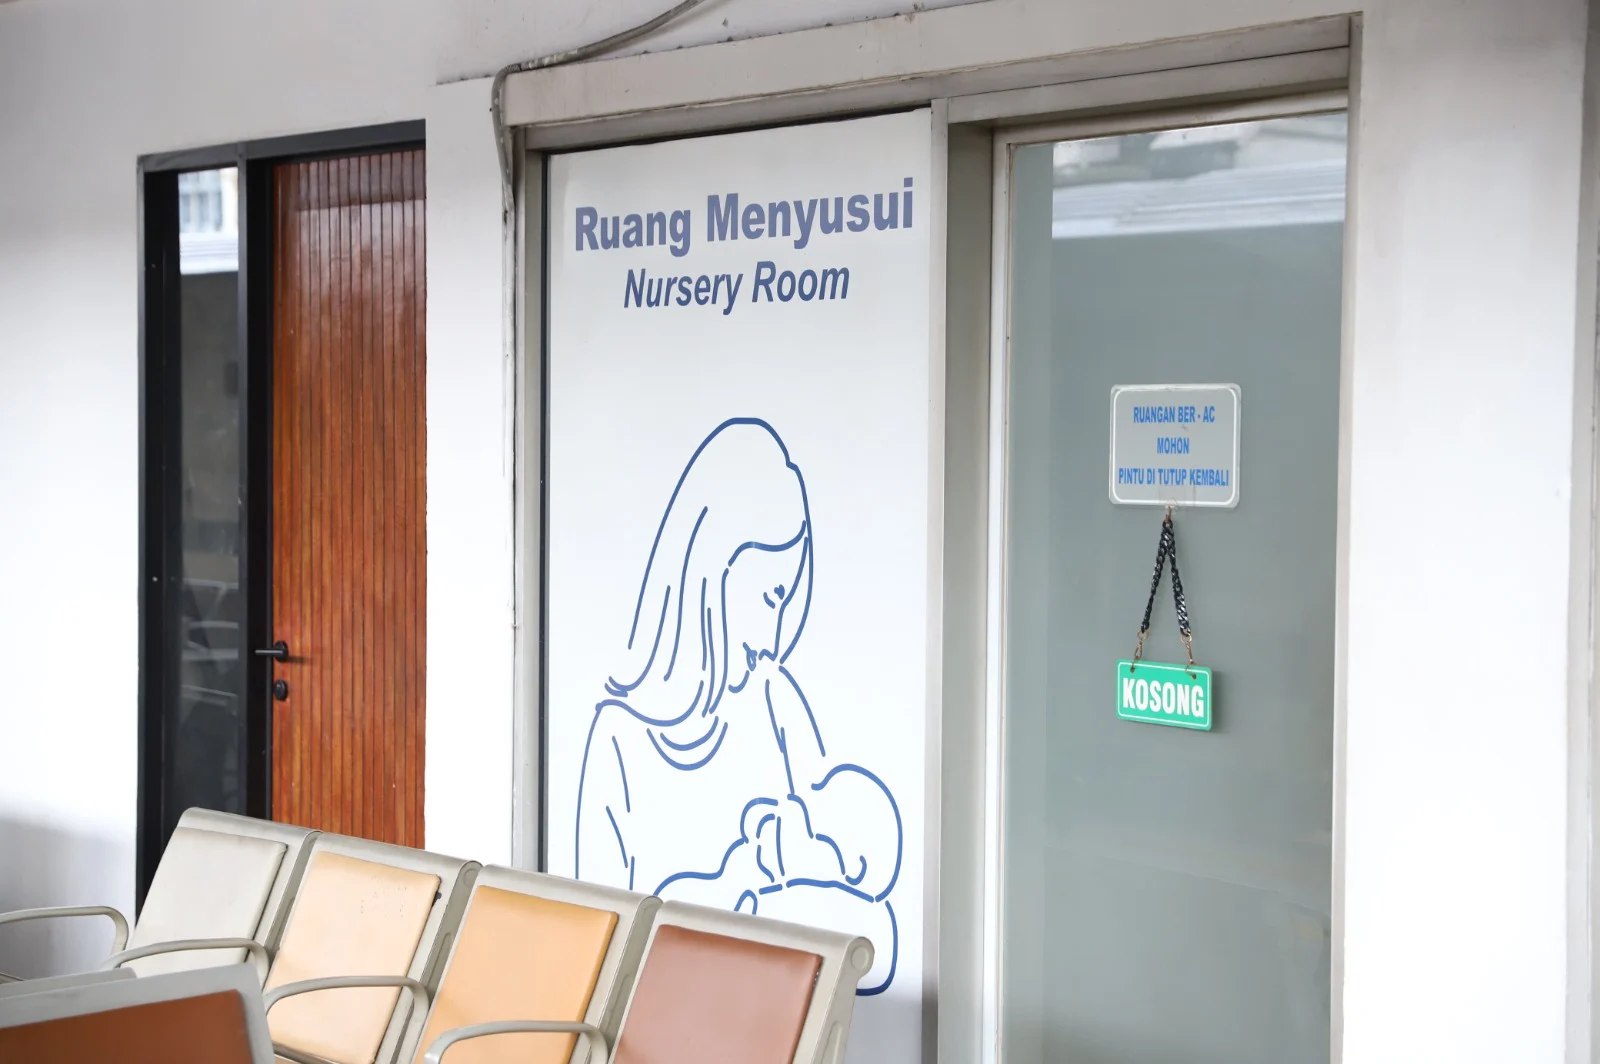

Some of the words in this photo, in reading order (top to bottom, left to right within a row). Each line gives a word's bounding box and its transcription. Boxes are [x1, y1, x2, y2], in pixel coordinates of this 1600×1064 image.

[575, 206, 691, 257] Ruang
[707, 177, 913, 249] Menyusui
[624, 268, 743, 315] Nursery
[752, 261, 850, 303] Room
[1133, 406, 1175, 423] RUANGAN
[1178, 406, 1195, 423] BER
[1202, 406, 1215, 422] AC
[1157, 437, 1190, 454] MOHON
[1118, 468, 1144, 484] PINTU
[1147, 468, 1155, 485] DI
[1158, 468, 1187, 485] TUTUP
[1190, 468, 1229, 487] KEMBALI
[1123, 677, 1204, 717] KOSONG
